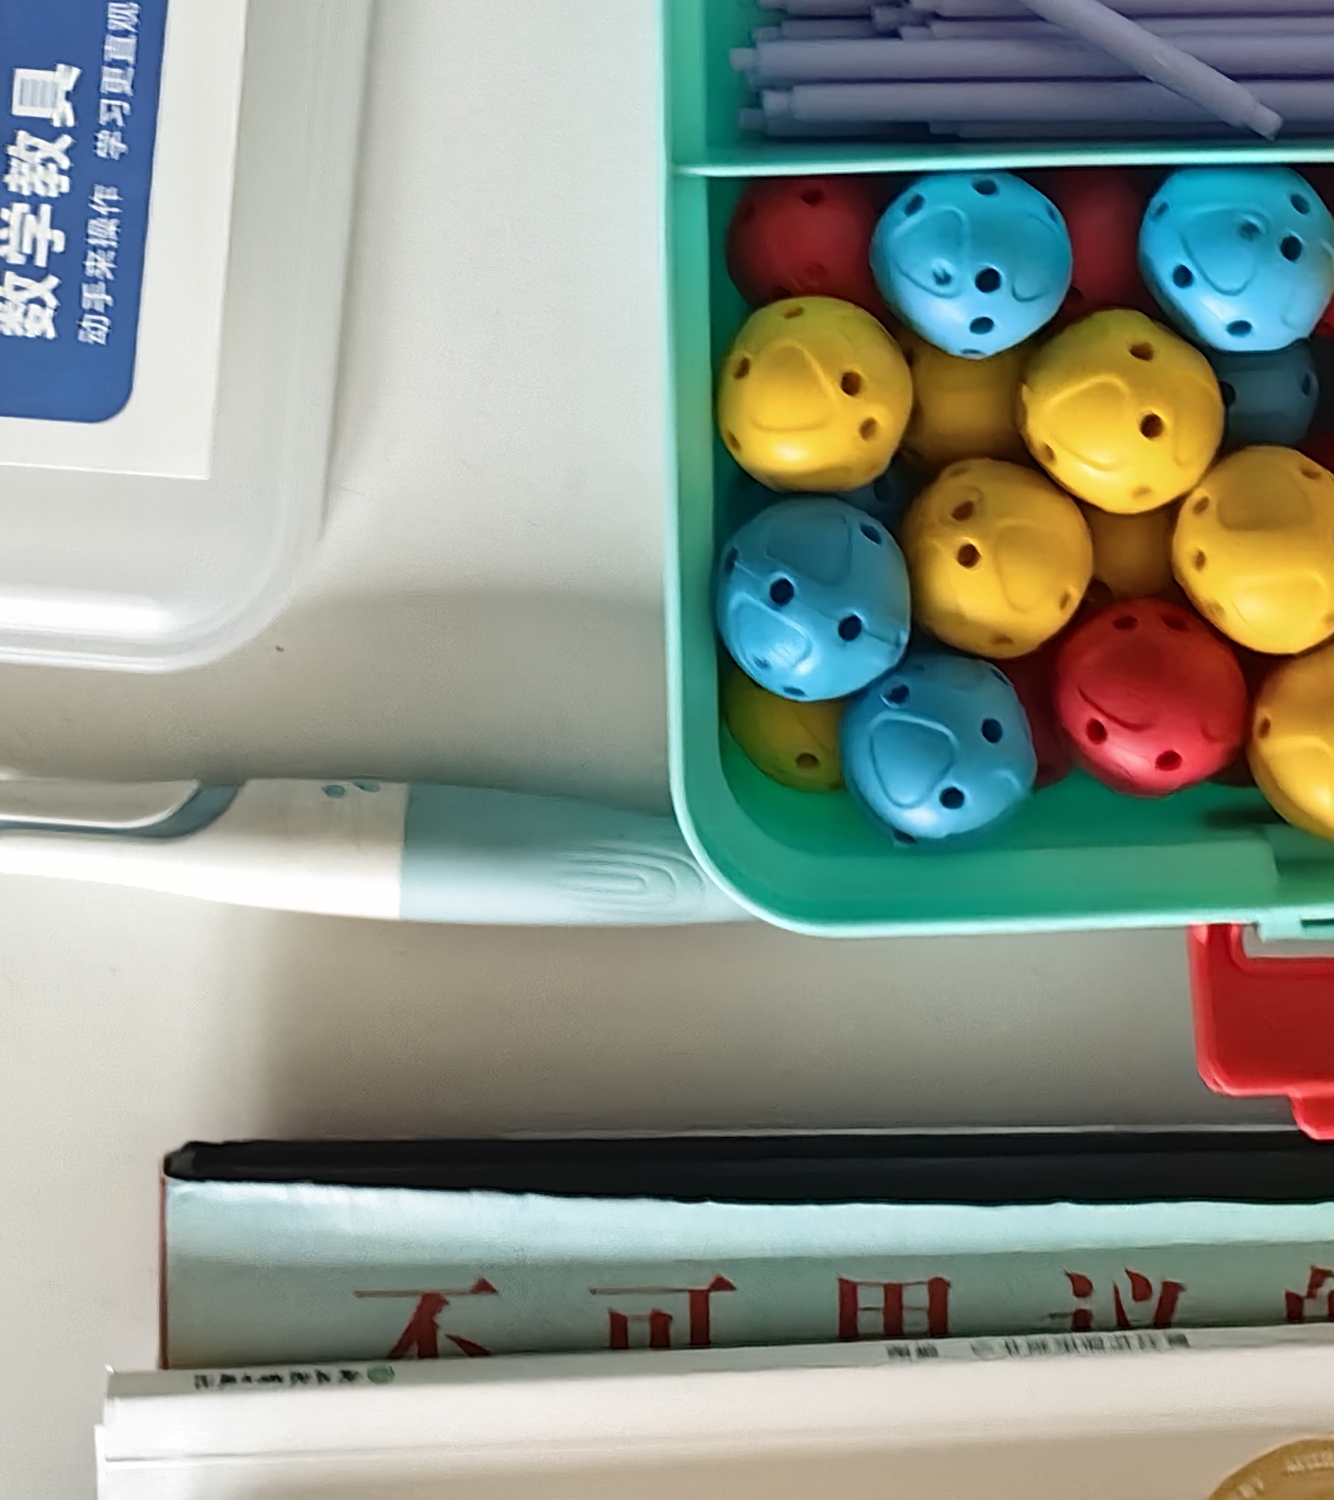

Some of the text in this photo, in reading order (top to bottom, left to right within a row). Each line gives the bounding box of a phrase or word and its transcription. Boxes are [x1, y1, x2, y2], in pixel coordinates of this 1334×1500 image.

[76, 1, 142, 346] 动手来操作 学习更直观
